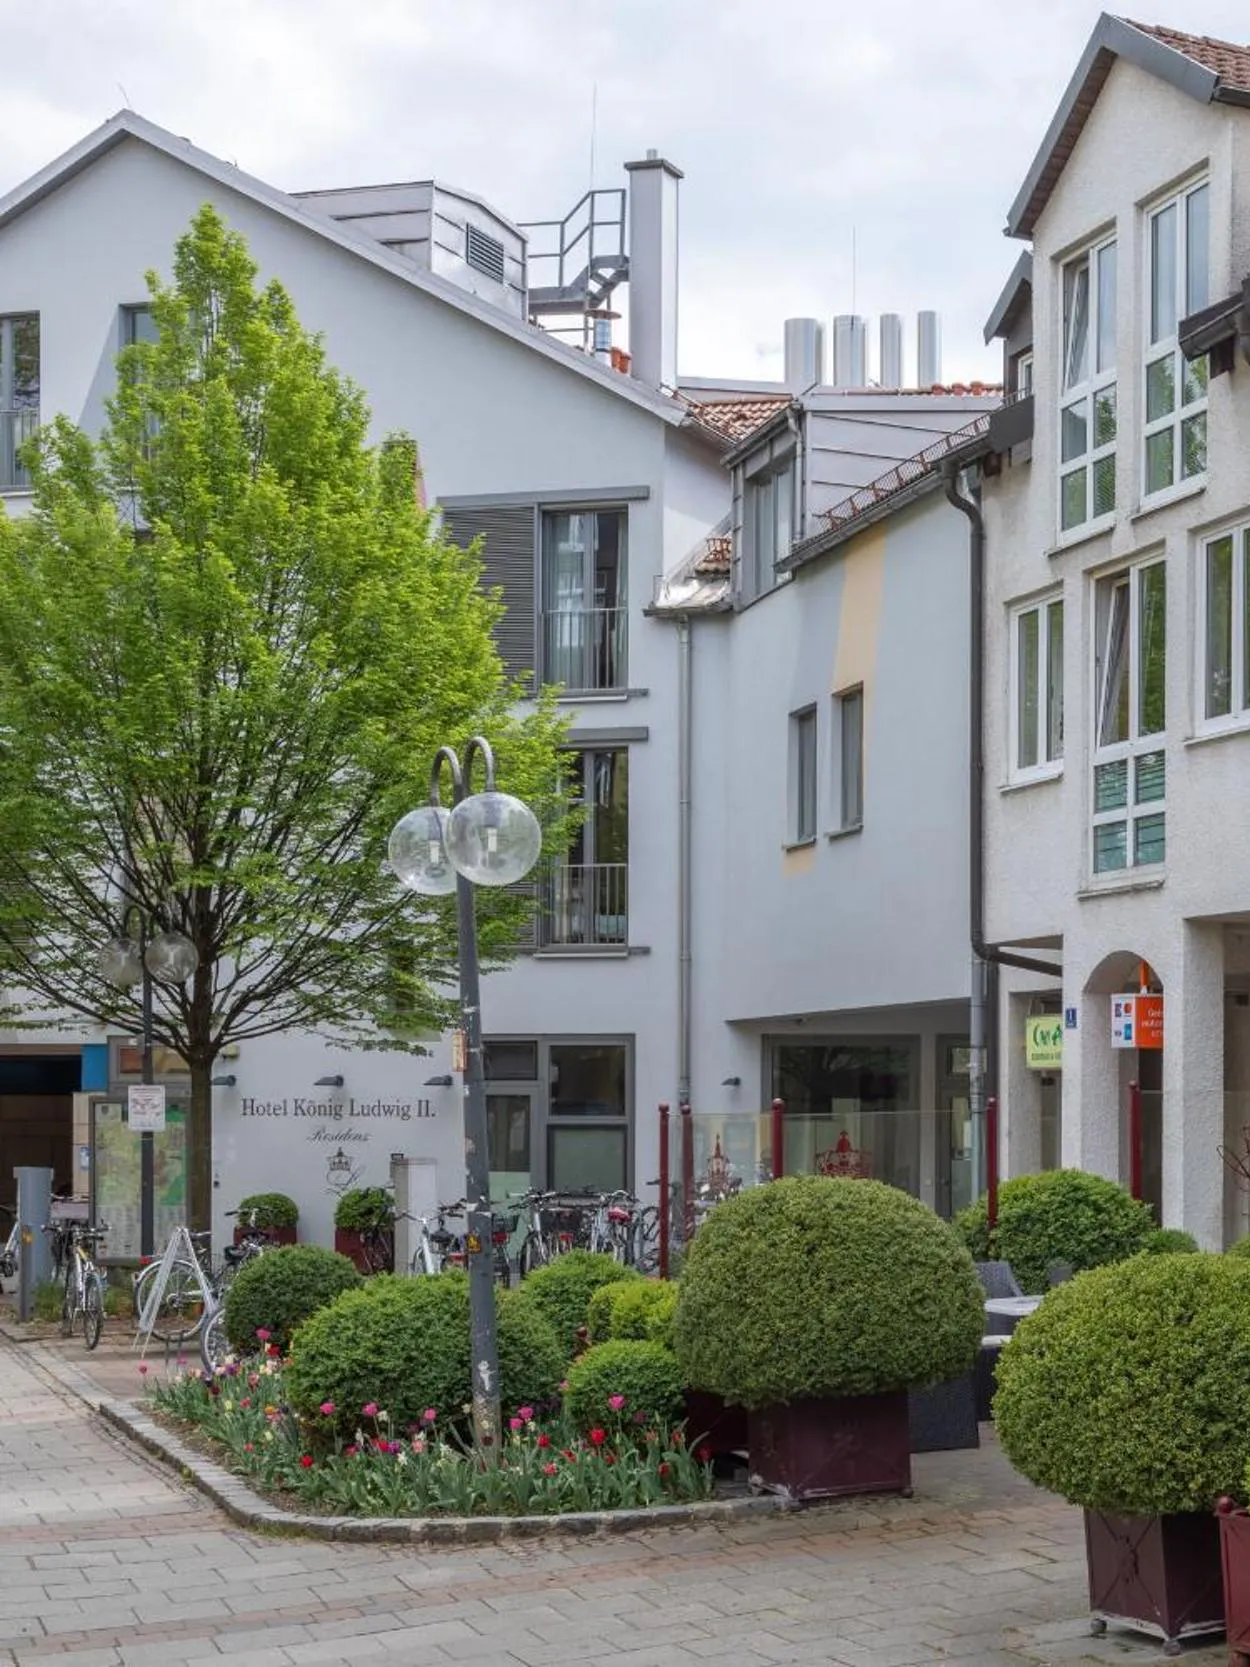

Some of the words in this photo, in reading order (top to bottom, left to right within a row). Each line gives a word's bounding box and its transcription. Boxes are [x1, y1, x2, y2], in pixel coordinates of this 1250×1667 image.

[241, 1097, 288, 1117] Hotel
[293, 1097, 344, 1121] König
[350, 1098, 411, 1121] Ludwig
[416, 1099, 437, 1118] II.
